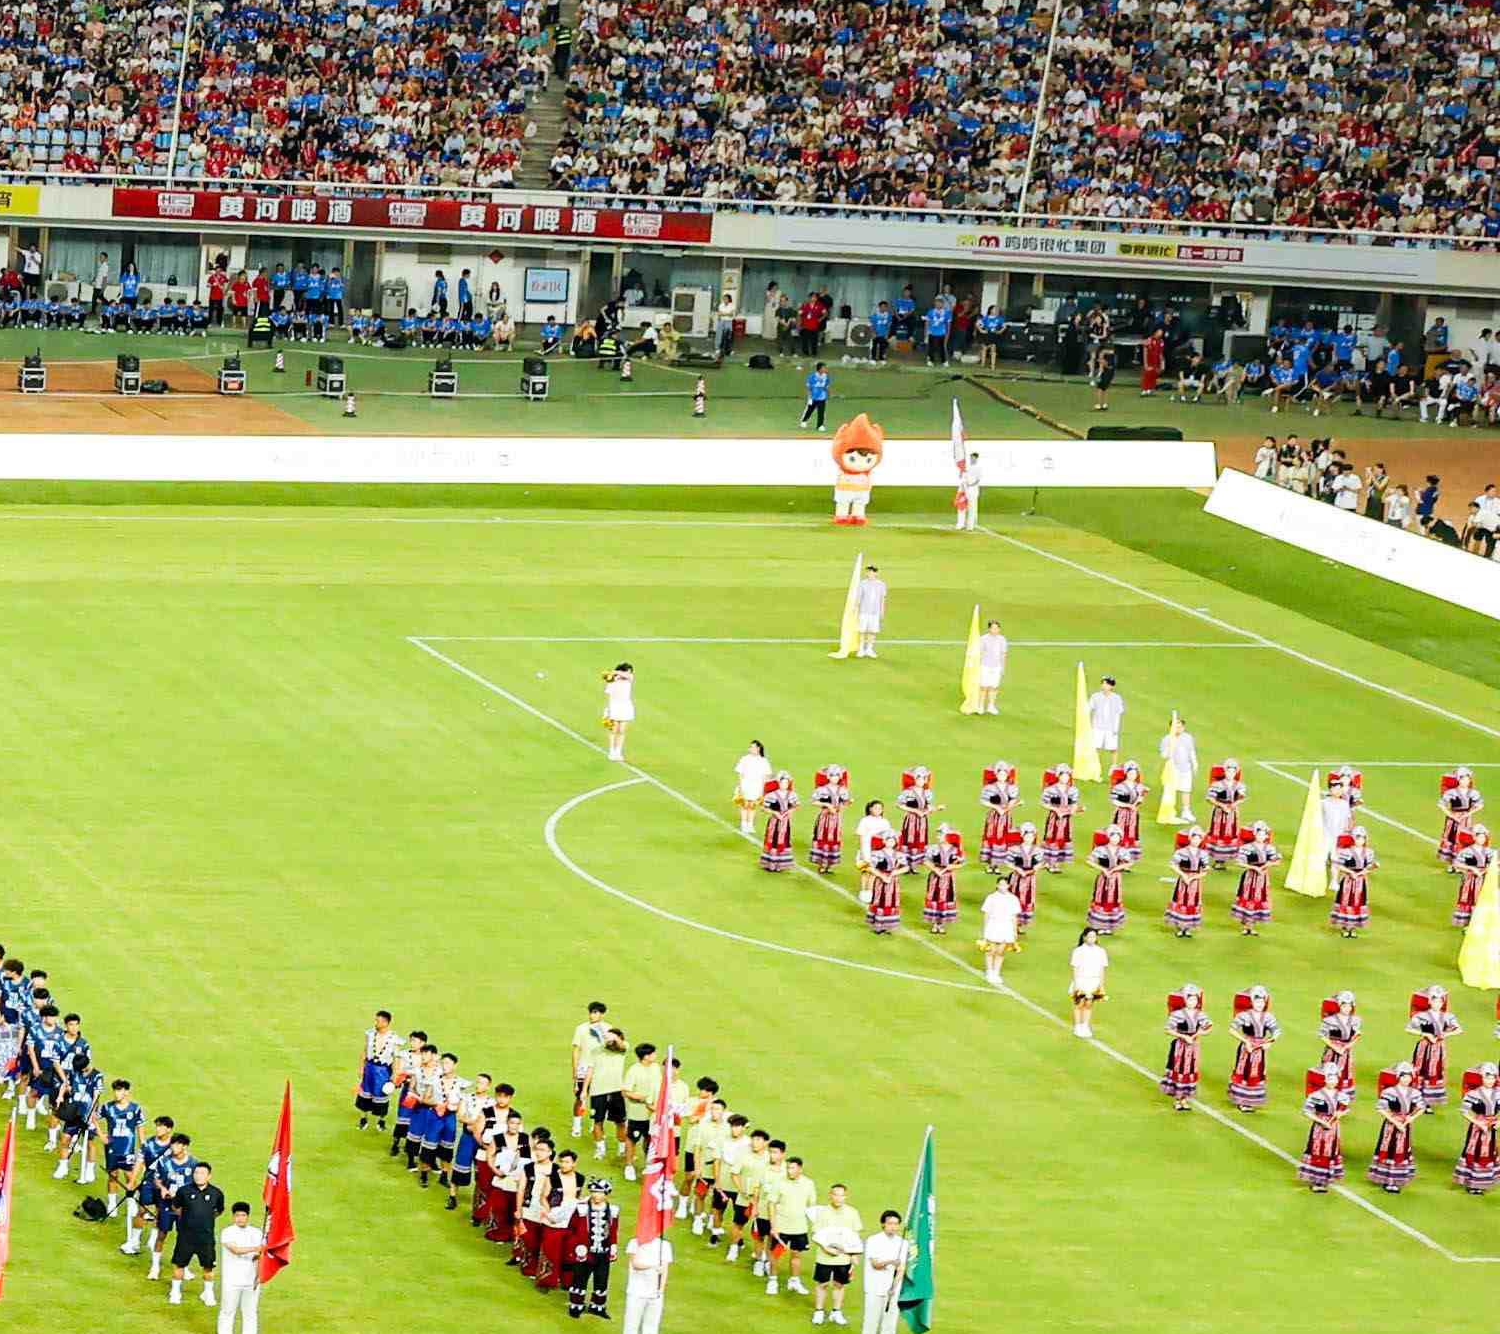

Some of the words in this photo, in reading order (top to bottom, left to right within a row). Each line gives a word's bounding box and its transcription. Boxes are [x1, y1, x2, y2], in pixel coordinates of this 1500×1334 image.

[219, 196, 352, 221] 黄河啤酒
[460, 206, 597, 233] 黄河啤酒
